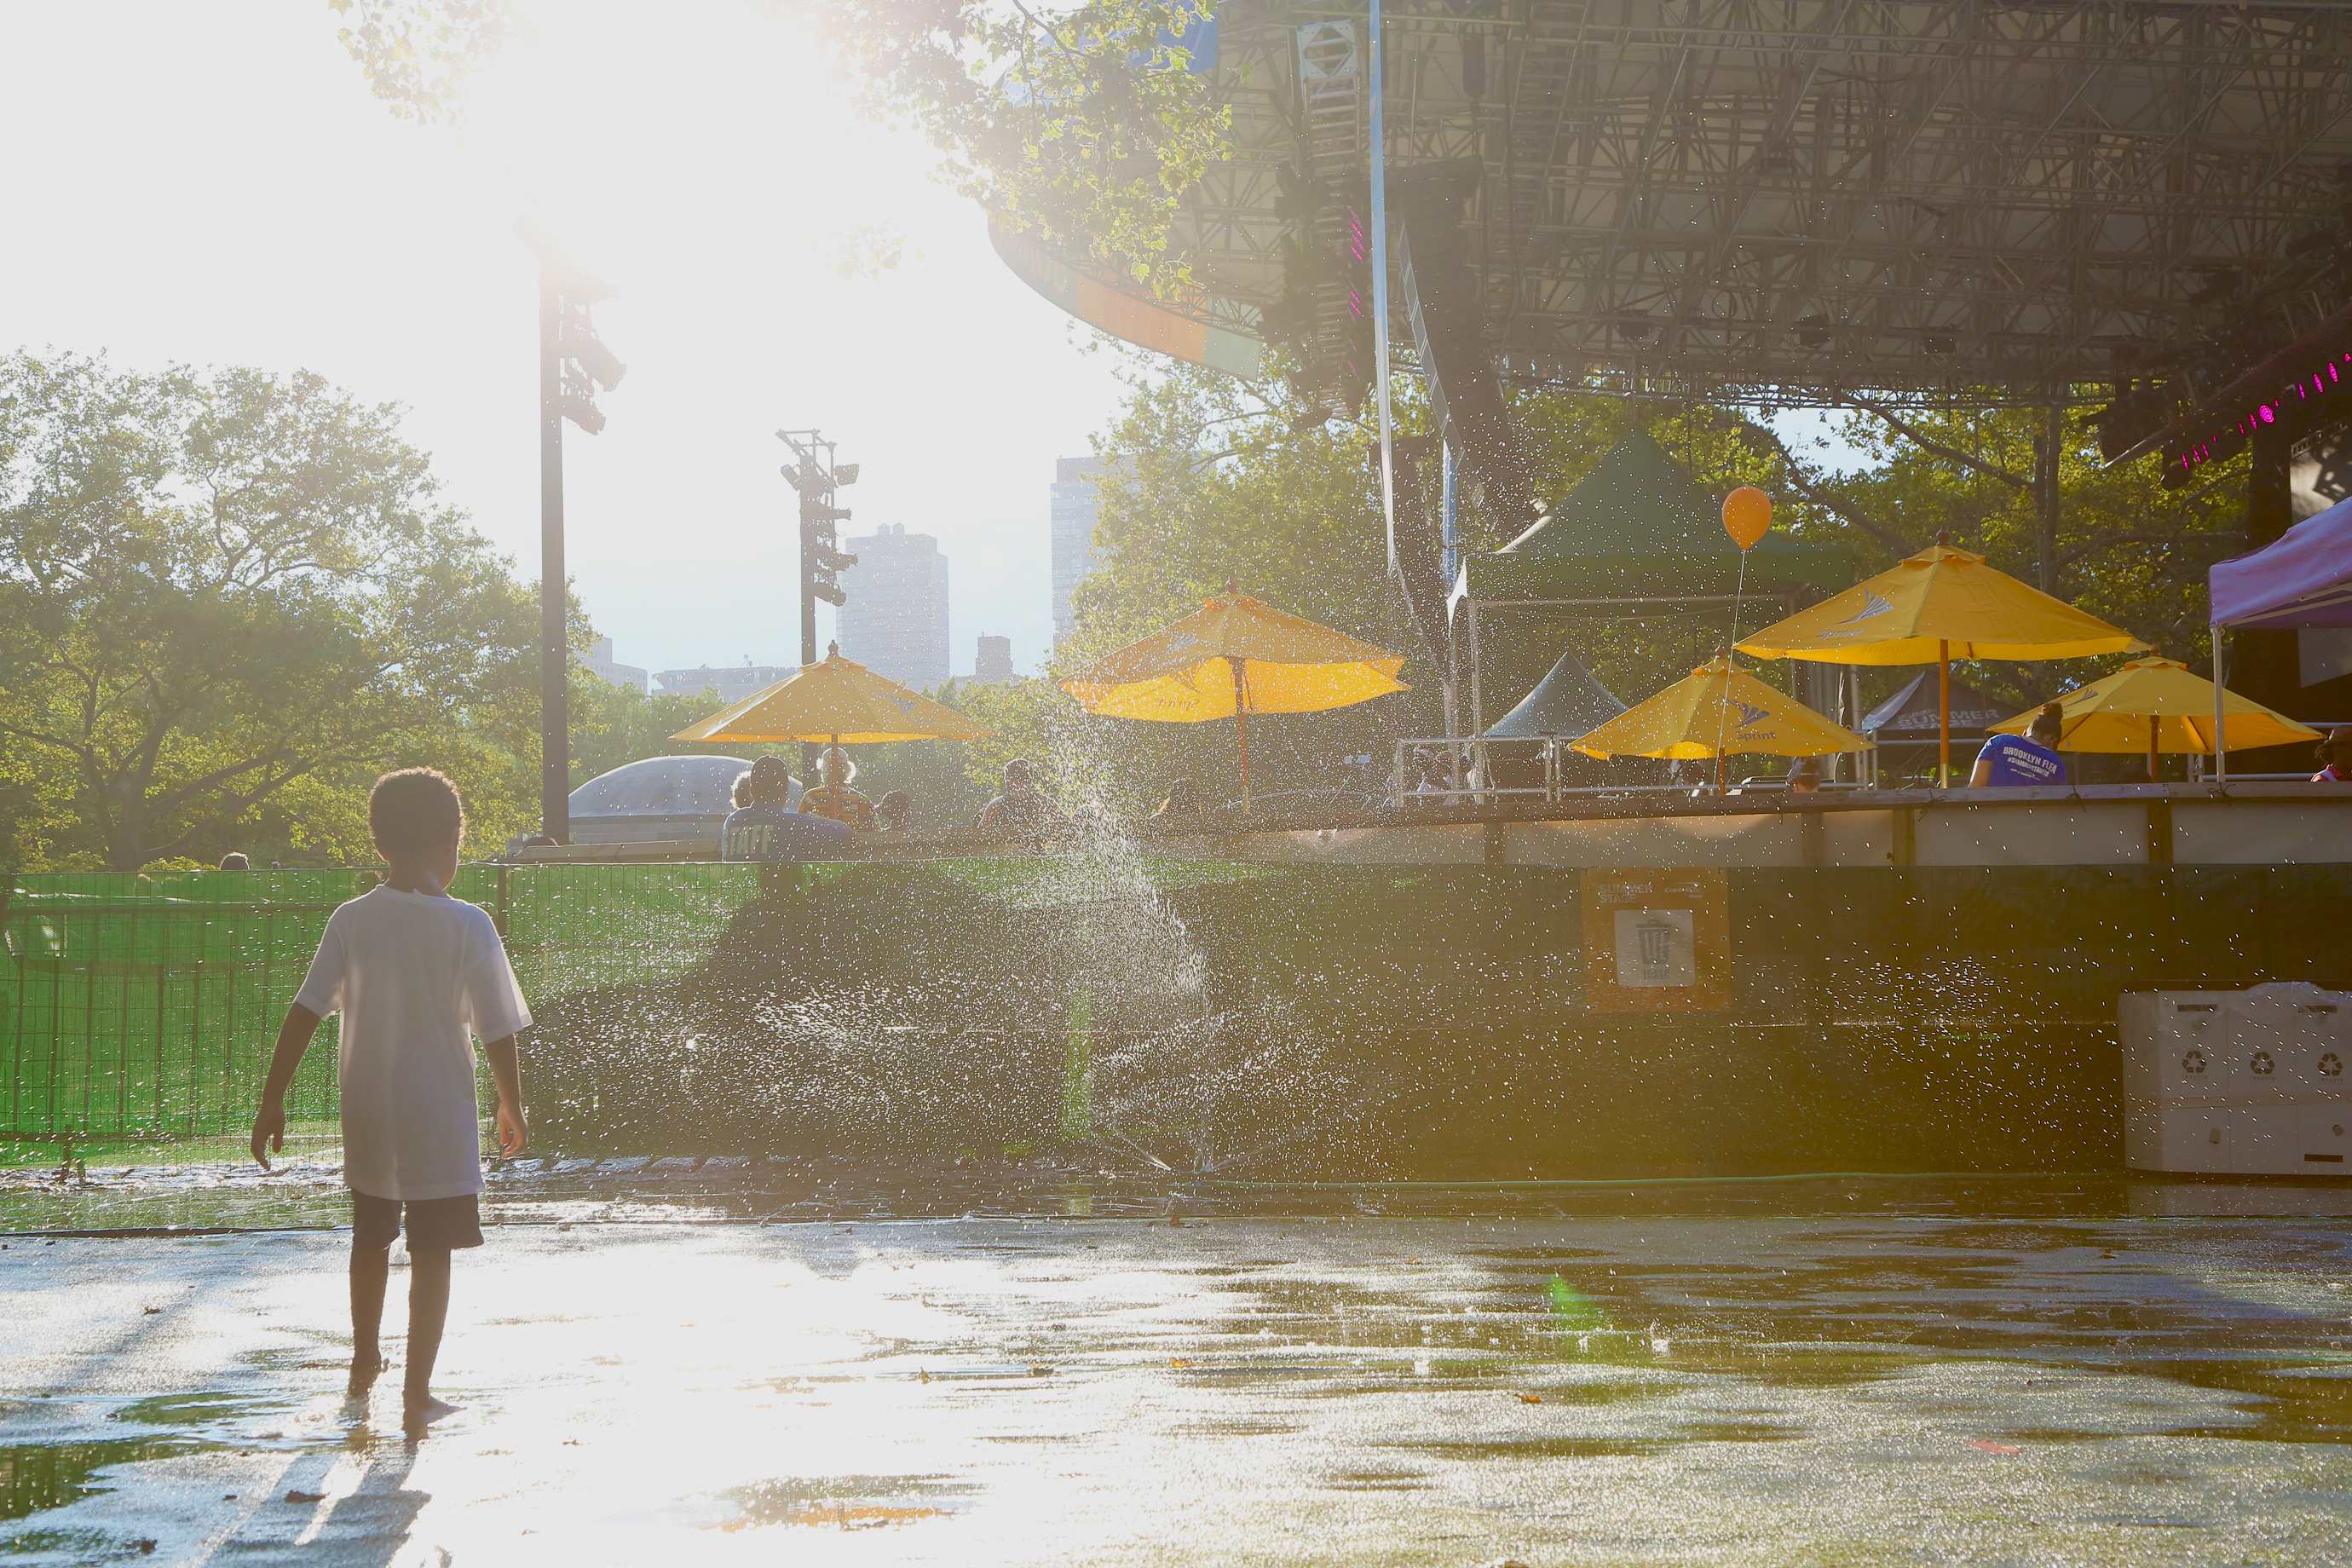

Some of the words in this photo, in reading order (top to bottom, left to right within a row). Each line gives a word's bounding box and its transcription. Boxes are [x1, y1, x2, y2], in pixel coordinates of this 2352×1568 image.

[1816, 629, 1866, 641] Sprint
[1737, 731, 1776, 741] Sprint
[2003, 747, 2042, 765] BROOKLYN
[2041, 759, 2058, 774] FLEA
[1599, 884, 1652, 894] SUMMER
[1600, 894, 1637, 903] STAGE
[1642, 969, 1669, 979] TRASH
